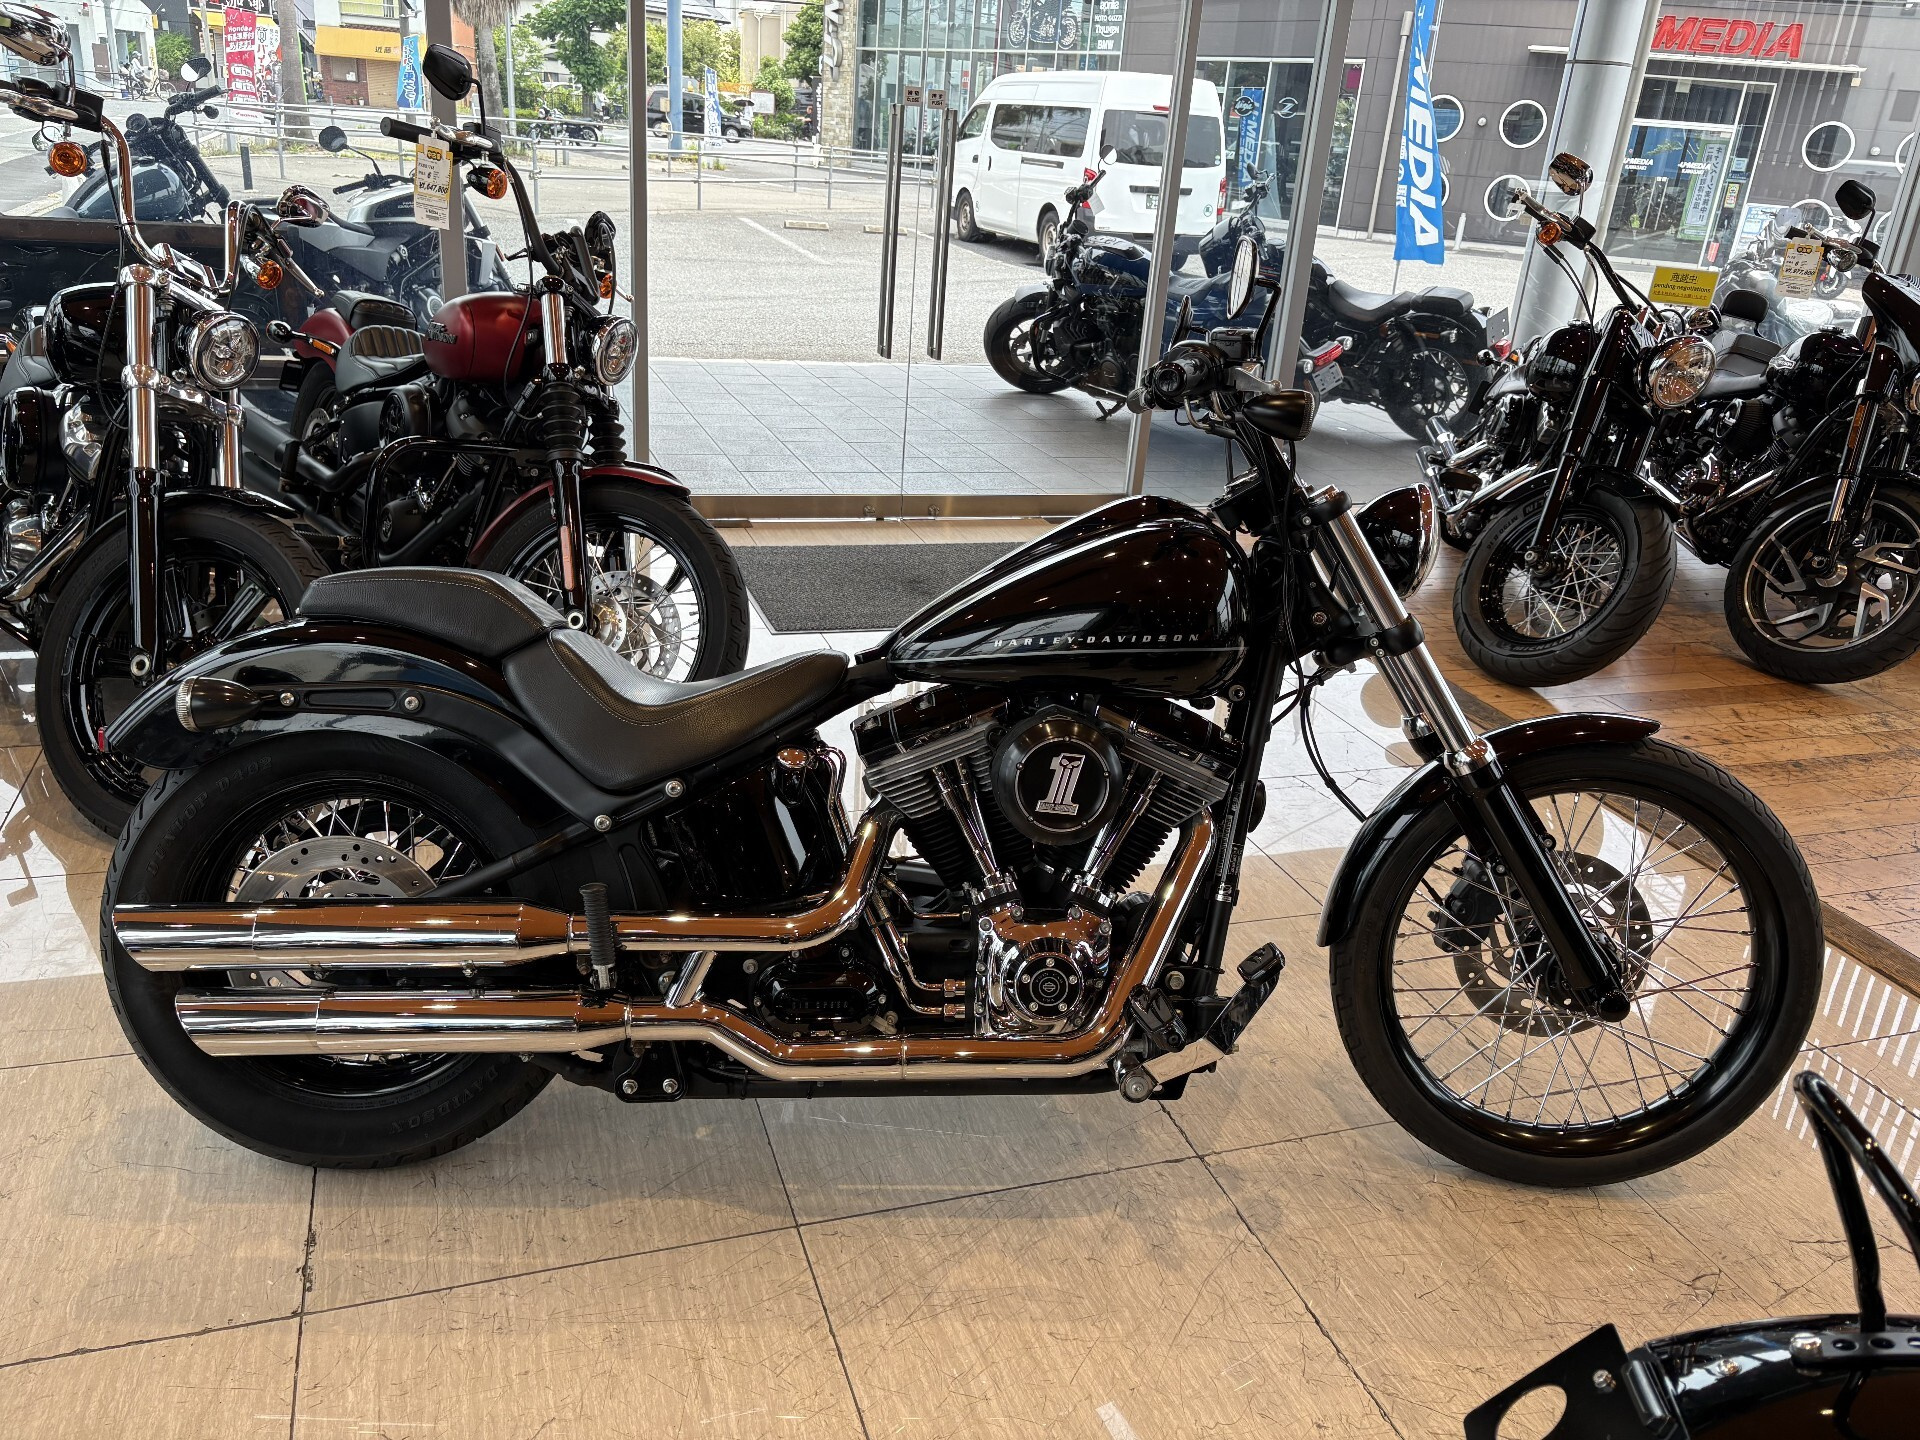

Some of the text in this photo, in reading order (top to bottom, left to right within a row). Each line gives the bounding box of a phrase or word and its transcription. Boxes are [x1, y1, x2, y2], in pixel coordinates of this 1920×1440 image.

[1097, 39, 1114, 49] BMW
[1653, 282, 1711, 293] pending negotiations
[994, 633, 1199, 648] HARLEY-DAVIDSON
[146, 755, 273, 877] DUNLOP D402
